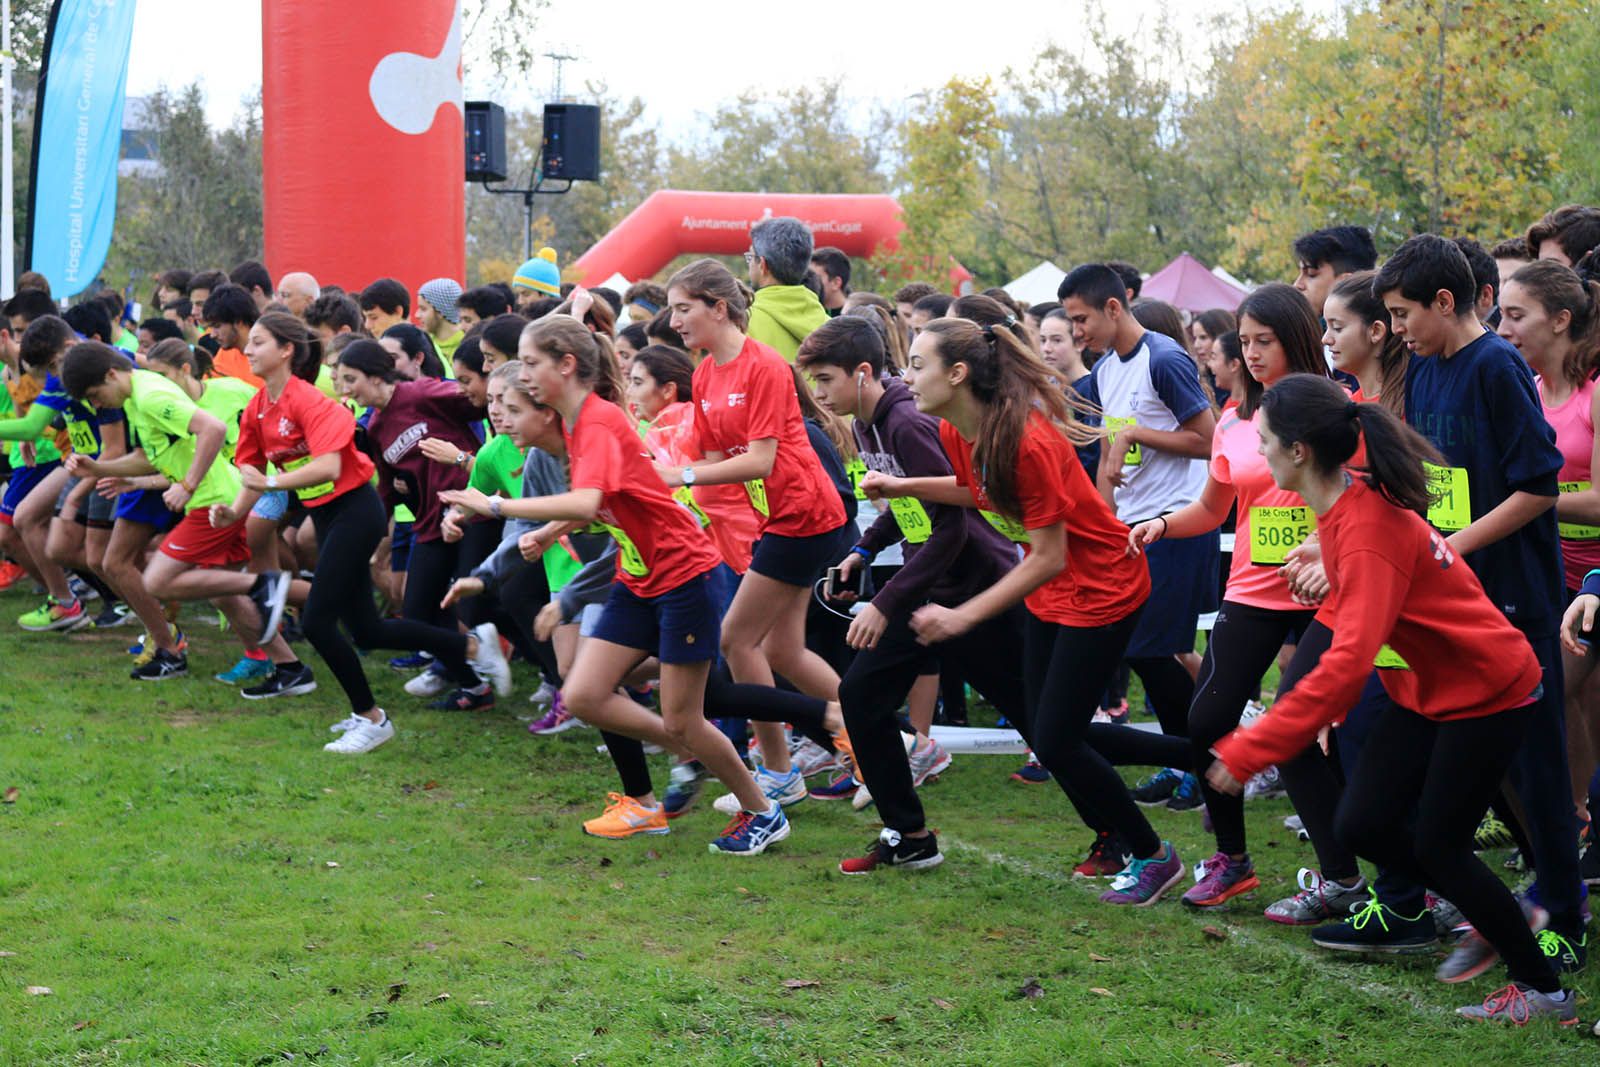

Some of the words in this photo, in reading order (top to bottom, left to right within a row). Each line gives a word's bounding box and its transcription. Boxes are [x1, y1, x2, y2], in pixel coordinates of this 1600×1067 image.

[85, 22, 98, 43] de
[77, 47, 97, 111] General
[69, 115, 89, 208] Universitari
[682, 216, 748, 230] Ajuntament
[65, 213, 84, 282] Hospital
[1273, 508, 1291, 517] Cros
[1258, 526, 1309, 546] 5085
[973, 739, 1016, 749] Ajuntament
